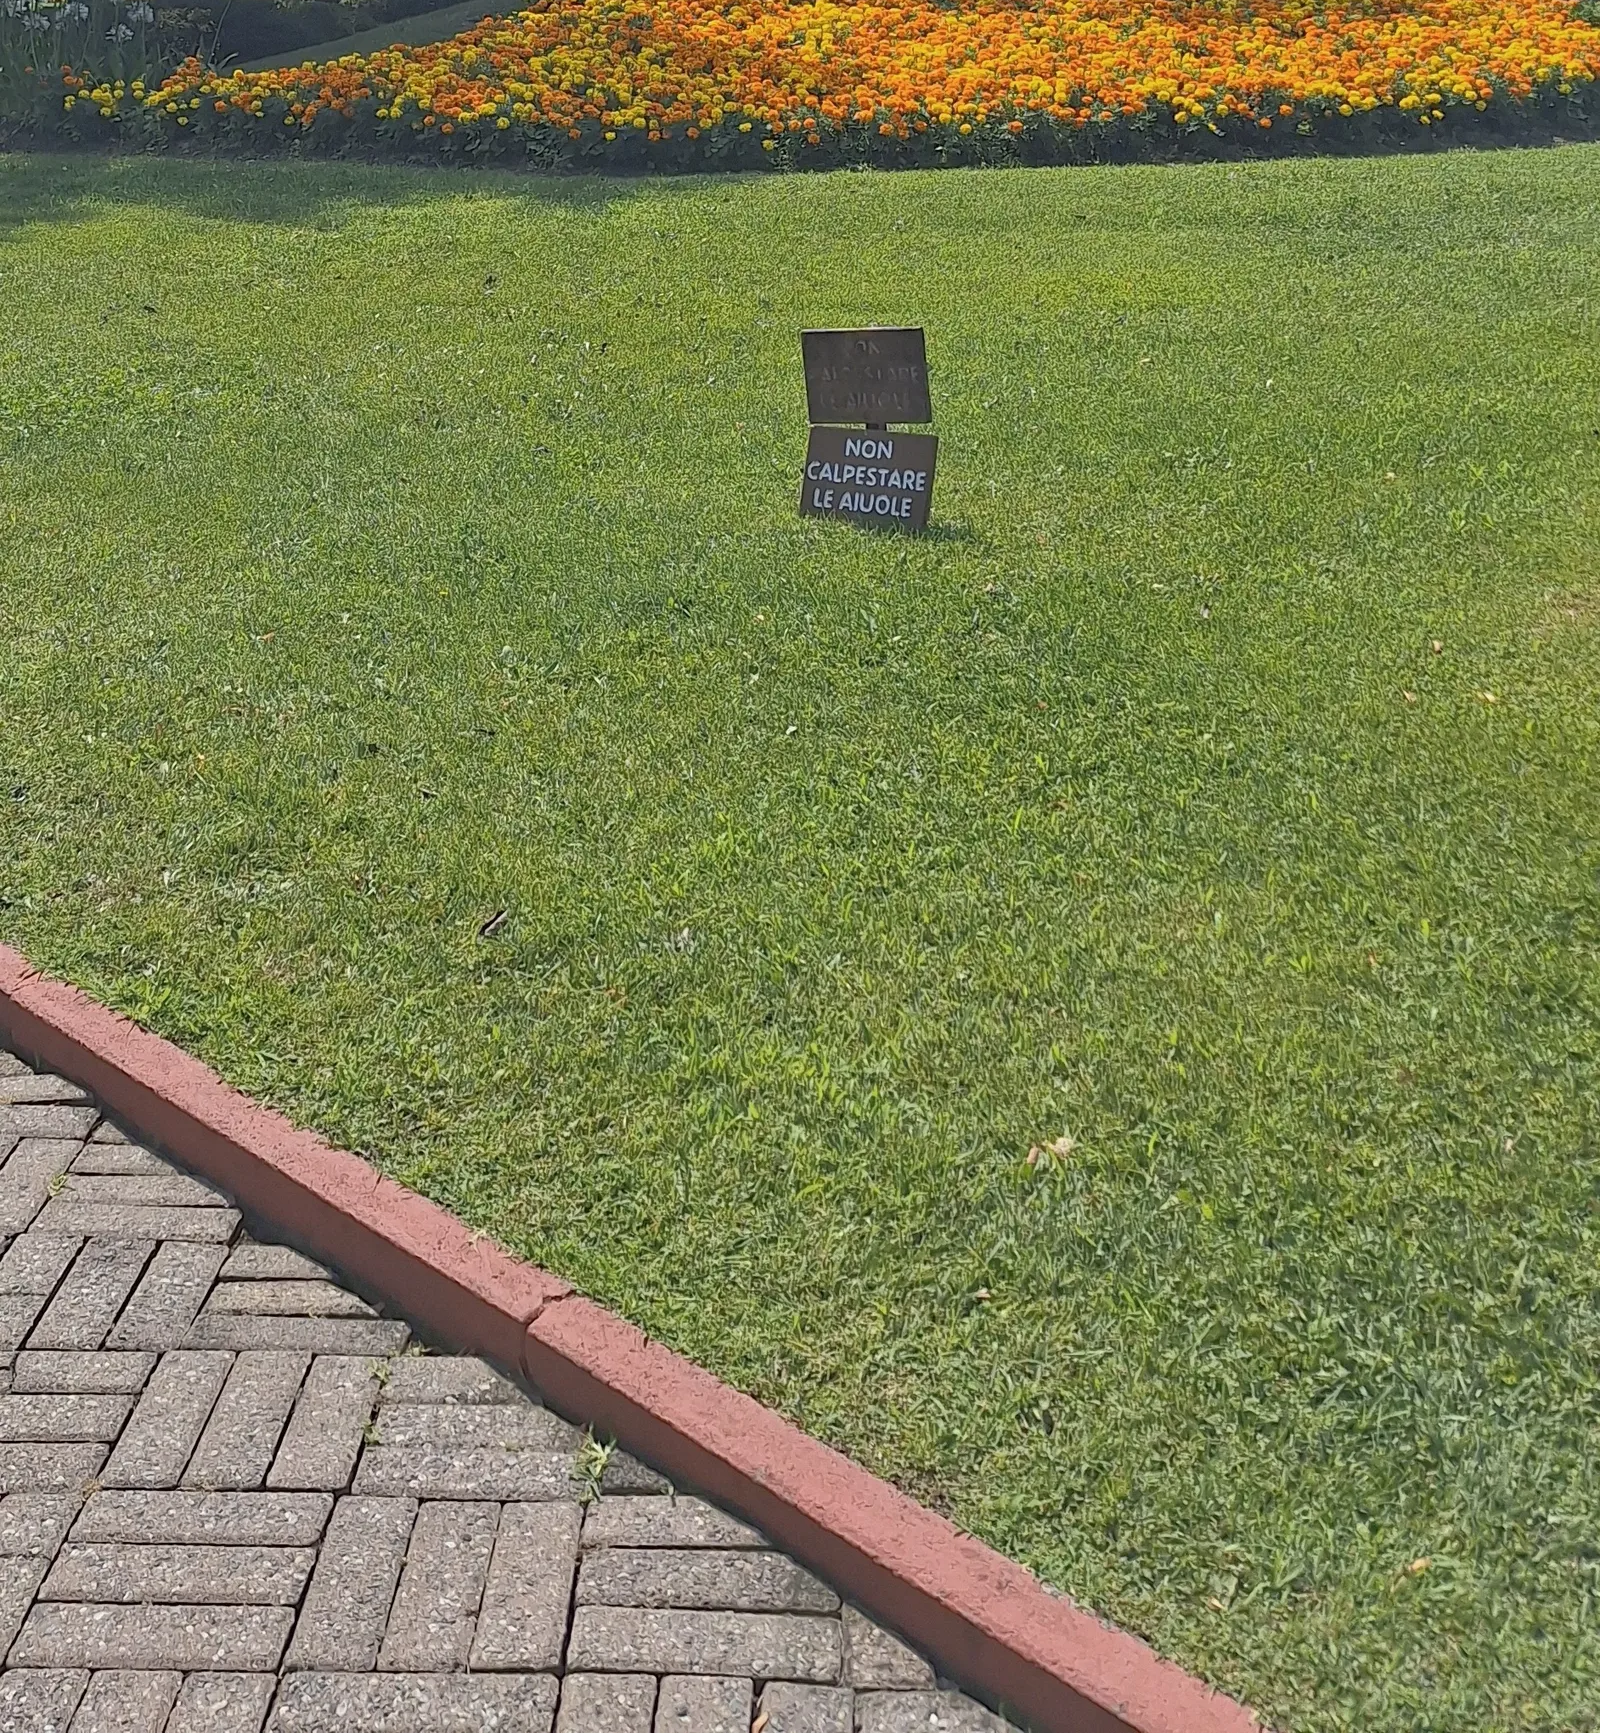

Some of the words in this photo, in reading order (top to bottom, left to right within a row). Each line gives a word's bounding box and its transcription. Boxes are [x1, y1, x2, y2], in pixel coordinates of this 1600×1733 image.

[845, 438, 893, 459] NON
[807, 461, 926, 491] CALPESTARE
[813, 487, 834, 508] LE
[838, 491, 912, 517] AIUOLE
